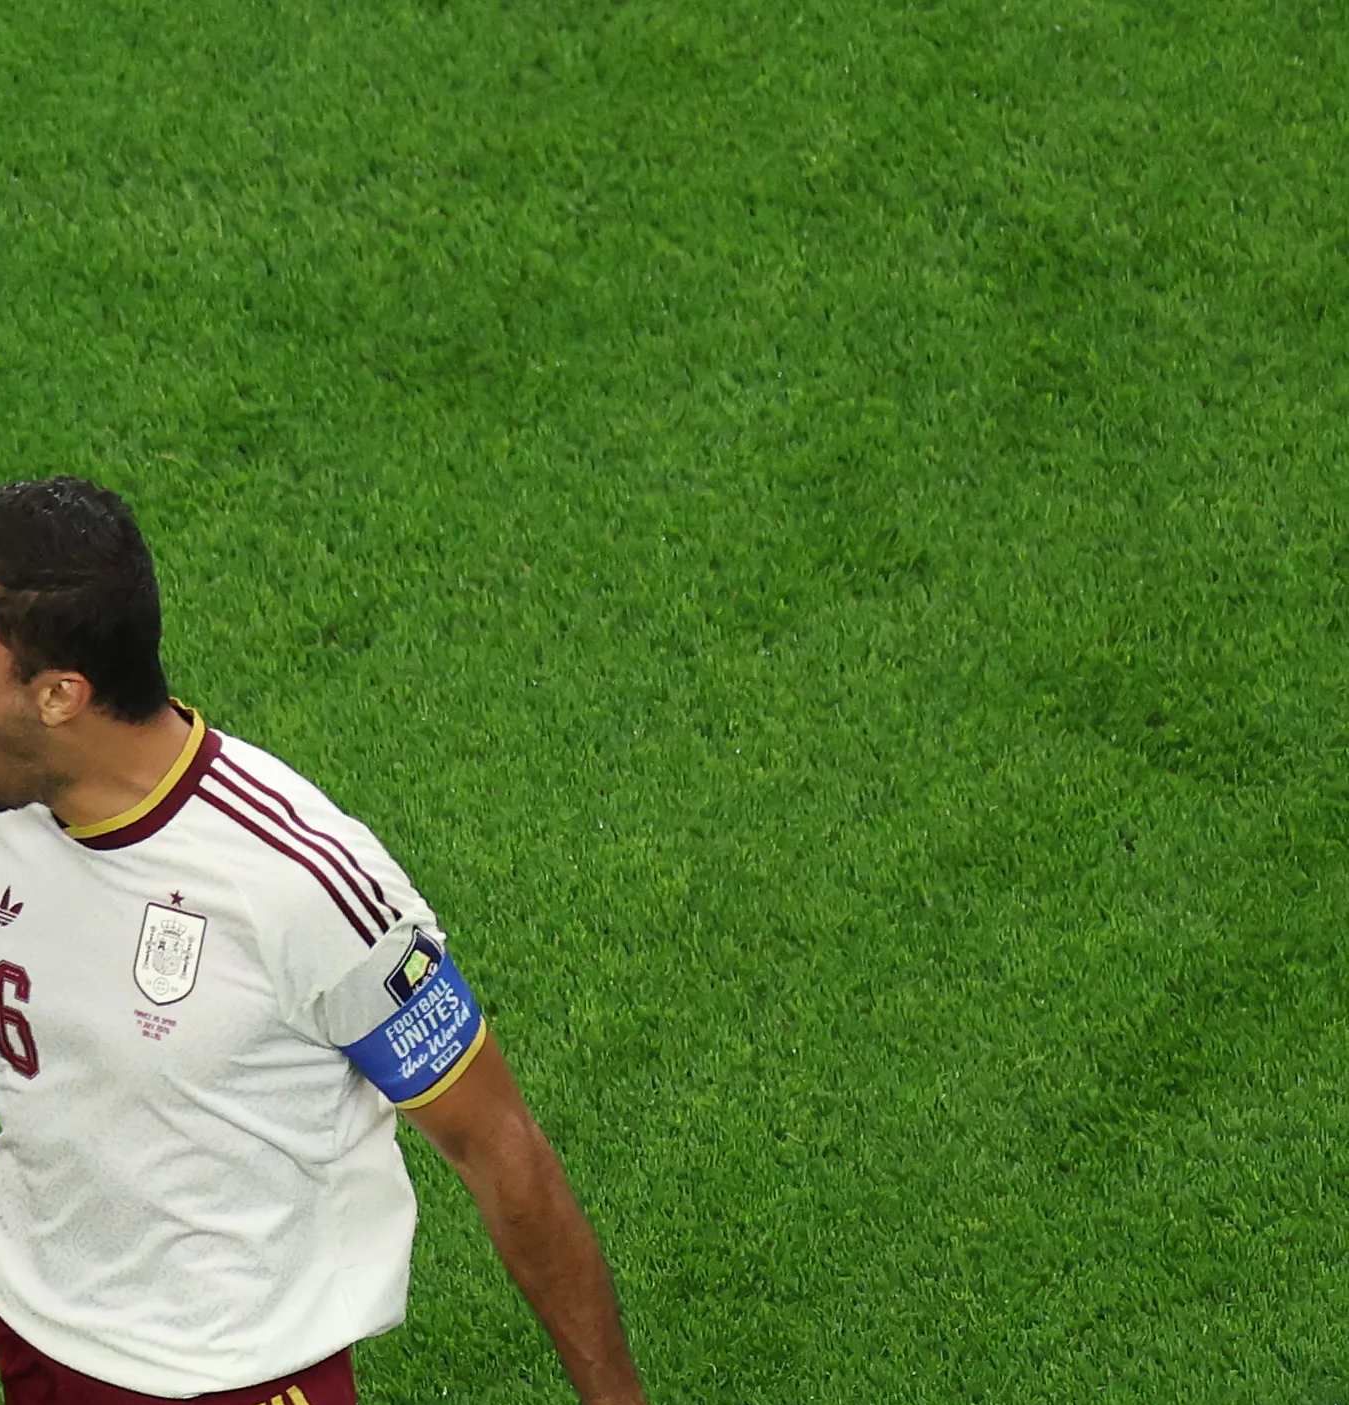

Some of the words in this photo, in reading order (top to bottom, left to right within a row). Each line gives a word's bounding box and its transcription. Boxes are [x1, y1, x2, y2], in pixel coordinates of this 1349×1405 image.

[386, 978, 450, 1041] FOOTBALL
[392, 988, 459, 1059] UNITES
[398, 1052, 428, 1079] the
[427, 1001, 471, 1055] World
